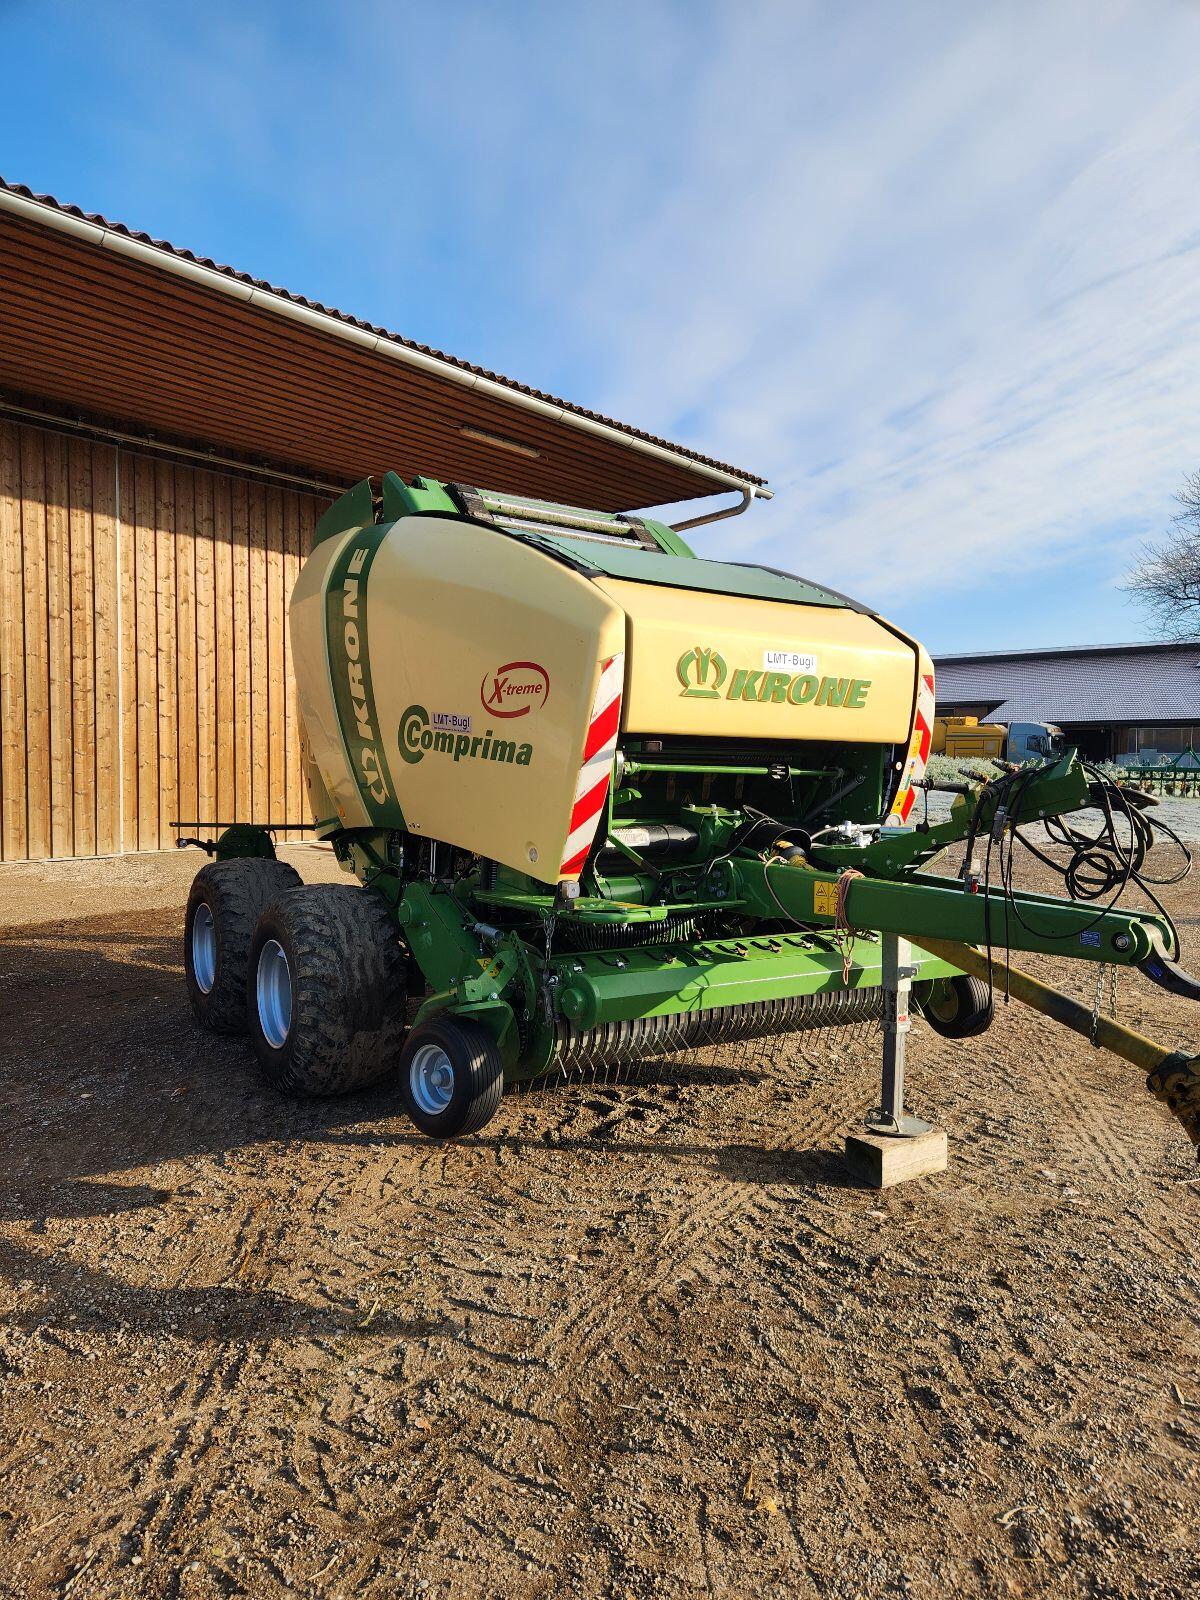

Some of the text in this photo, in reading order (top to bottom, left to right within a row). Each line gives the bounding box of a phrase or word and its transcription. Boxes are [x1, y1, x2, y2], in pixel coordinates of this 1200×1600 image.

[343, 548, 374, 740] KRONE
[767, 652, 814, 670] LMT-Bugl
[487, 677, 543, 704] X-treme
[727, 669, 872, 708] KRONE
[398, 704, 533, 766] Comprima
